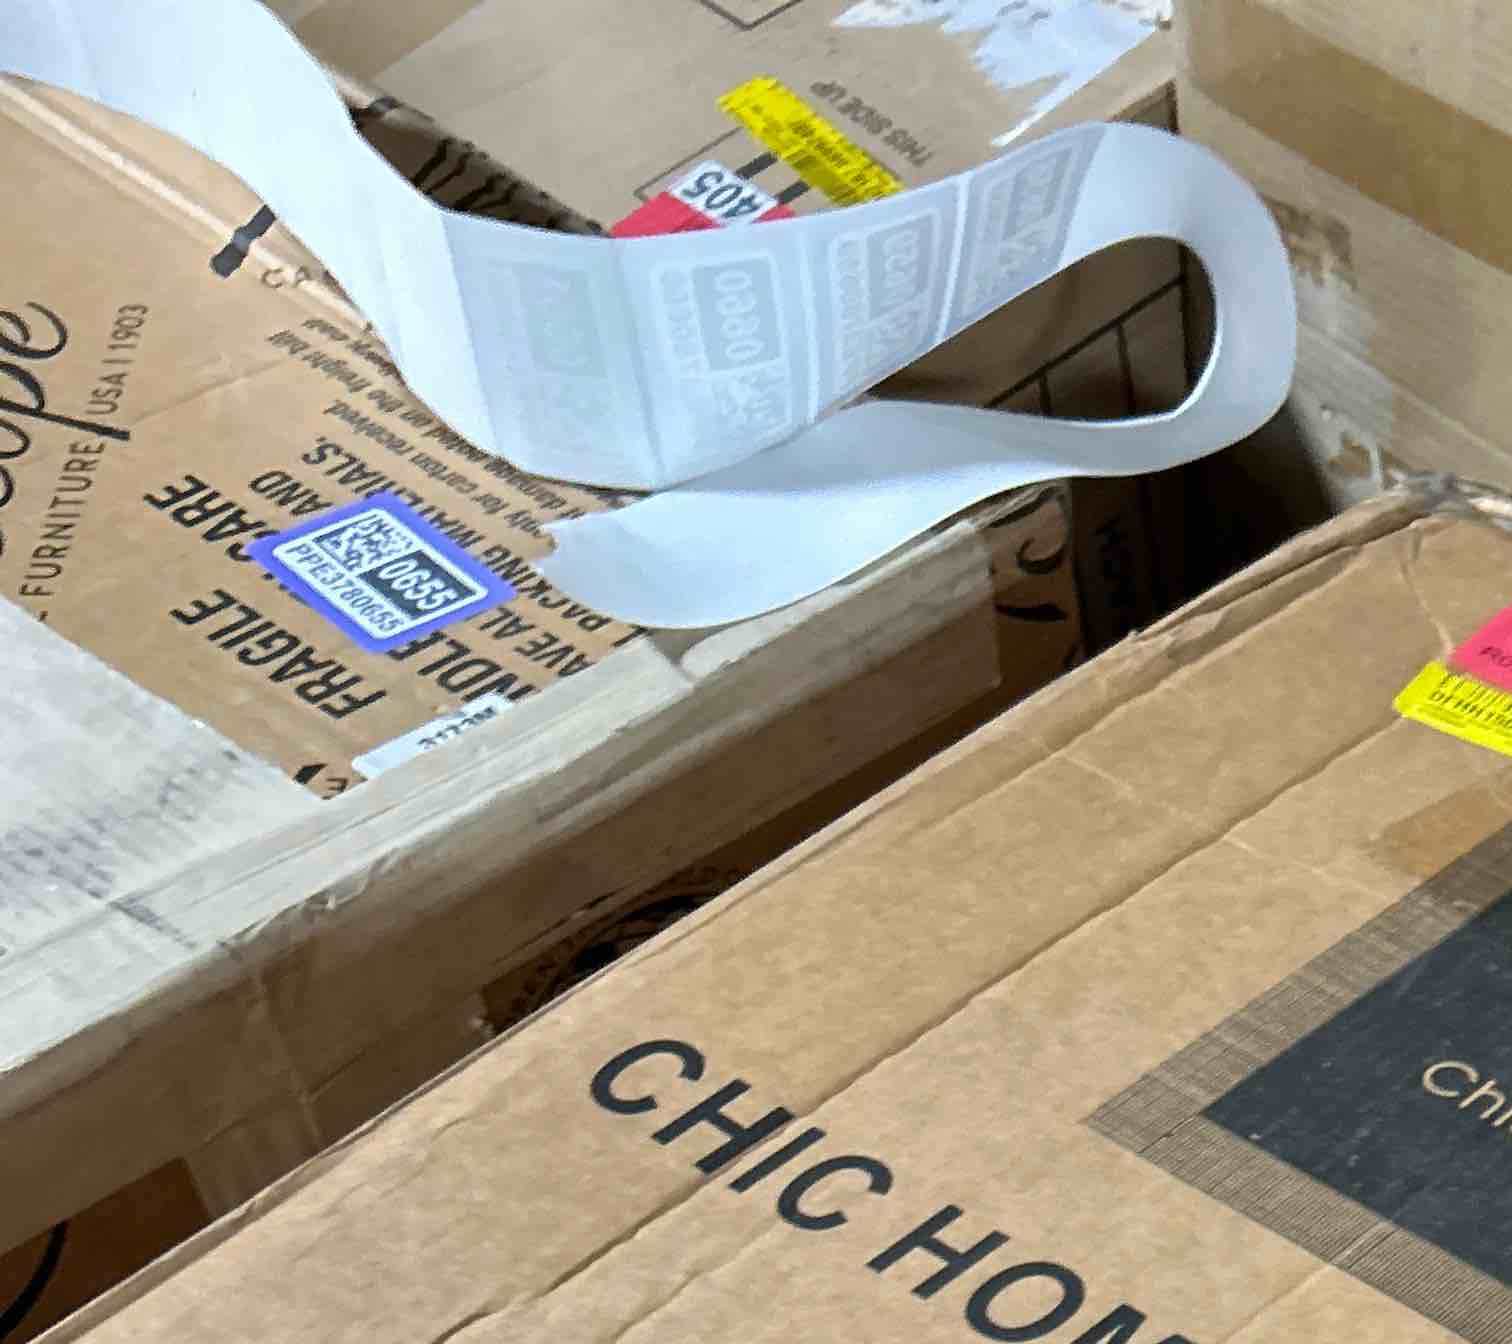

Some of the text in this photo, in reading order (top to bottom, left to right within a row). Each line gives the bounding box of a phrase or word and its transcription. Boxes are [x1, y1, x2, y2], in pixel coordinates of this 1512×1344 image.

[682, 170, 762, 218] 405
[18, 440, 105, 598] FURNITURE
[85, 372, 129, 416] USA
[116, 303, 149, 350] 1903
[249, 469, 333, 517] AND
[471, 493, 510, 515] for
[143, 474, 537, 703] NDLE CARE
[378, 560, 460, 611] 0655
[483, 544, 613, 632] PACKING
[168, 588, 388, 719] FRAGILE
[513, 631, 597, 678] AVE
[589, 1038, 894, 1231] CHIC
